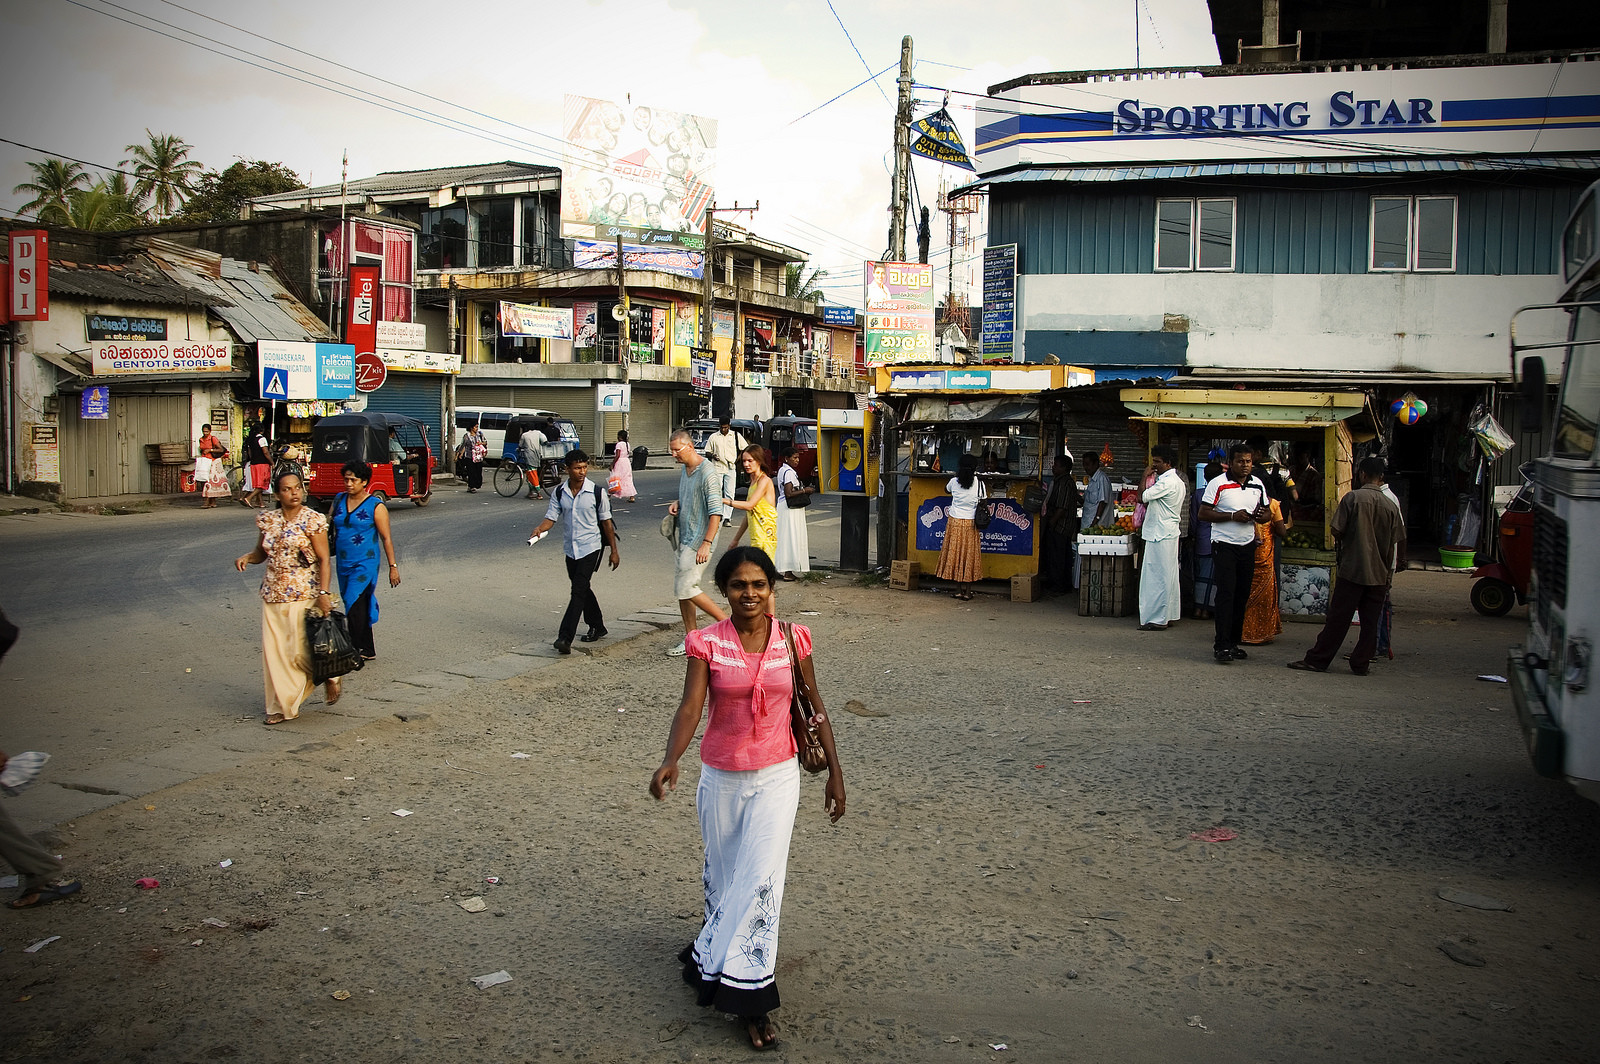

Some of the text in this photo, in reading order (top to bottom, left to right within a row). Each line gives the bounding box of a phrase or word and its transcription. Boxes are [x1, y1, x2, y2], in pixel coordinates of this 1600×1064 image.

[1116, 91, 1437, 133] SPORTING STAR
[612, 165, 661, 179] ROUGH
[641, 231, 652, 242] of
[653, 233, 673, 242] youth
[358, 278, 372, 322] Airtel
[263, 352, 305, 362] GOONASEKARA
[321, 355, 352, 366] Telecom
[113, 360, 170, 368] BENTOTA
